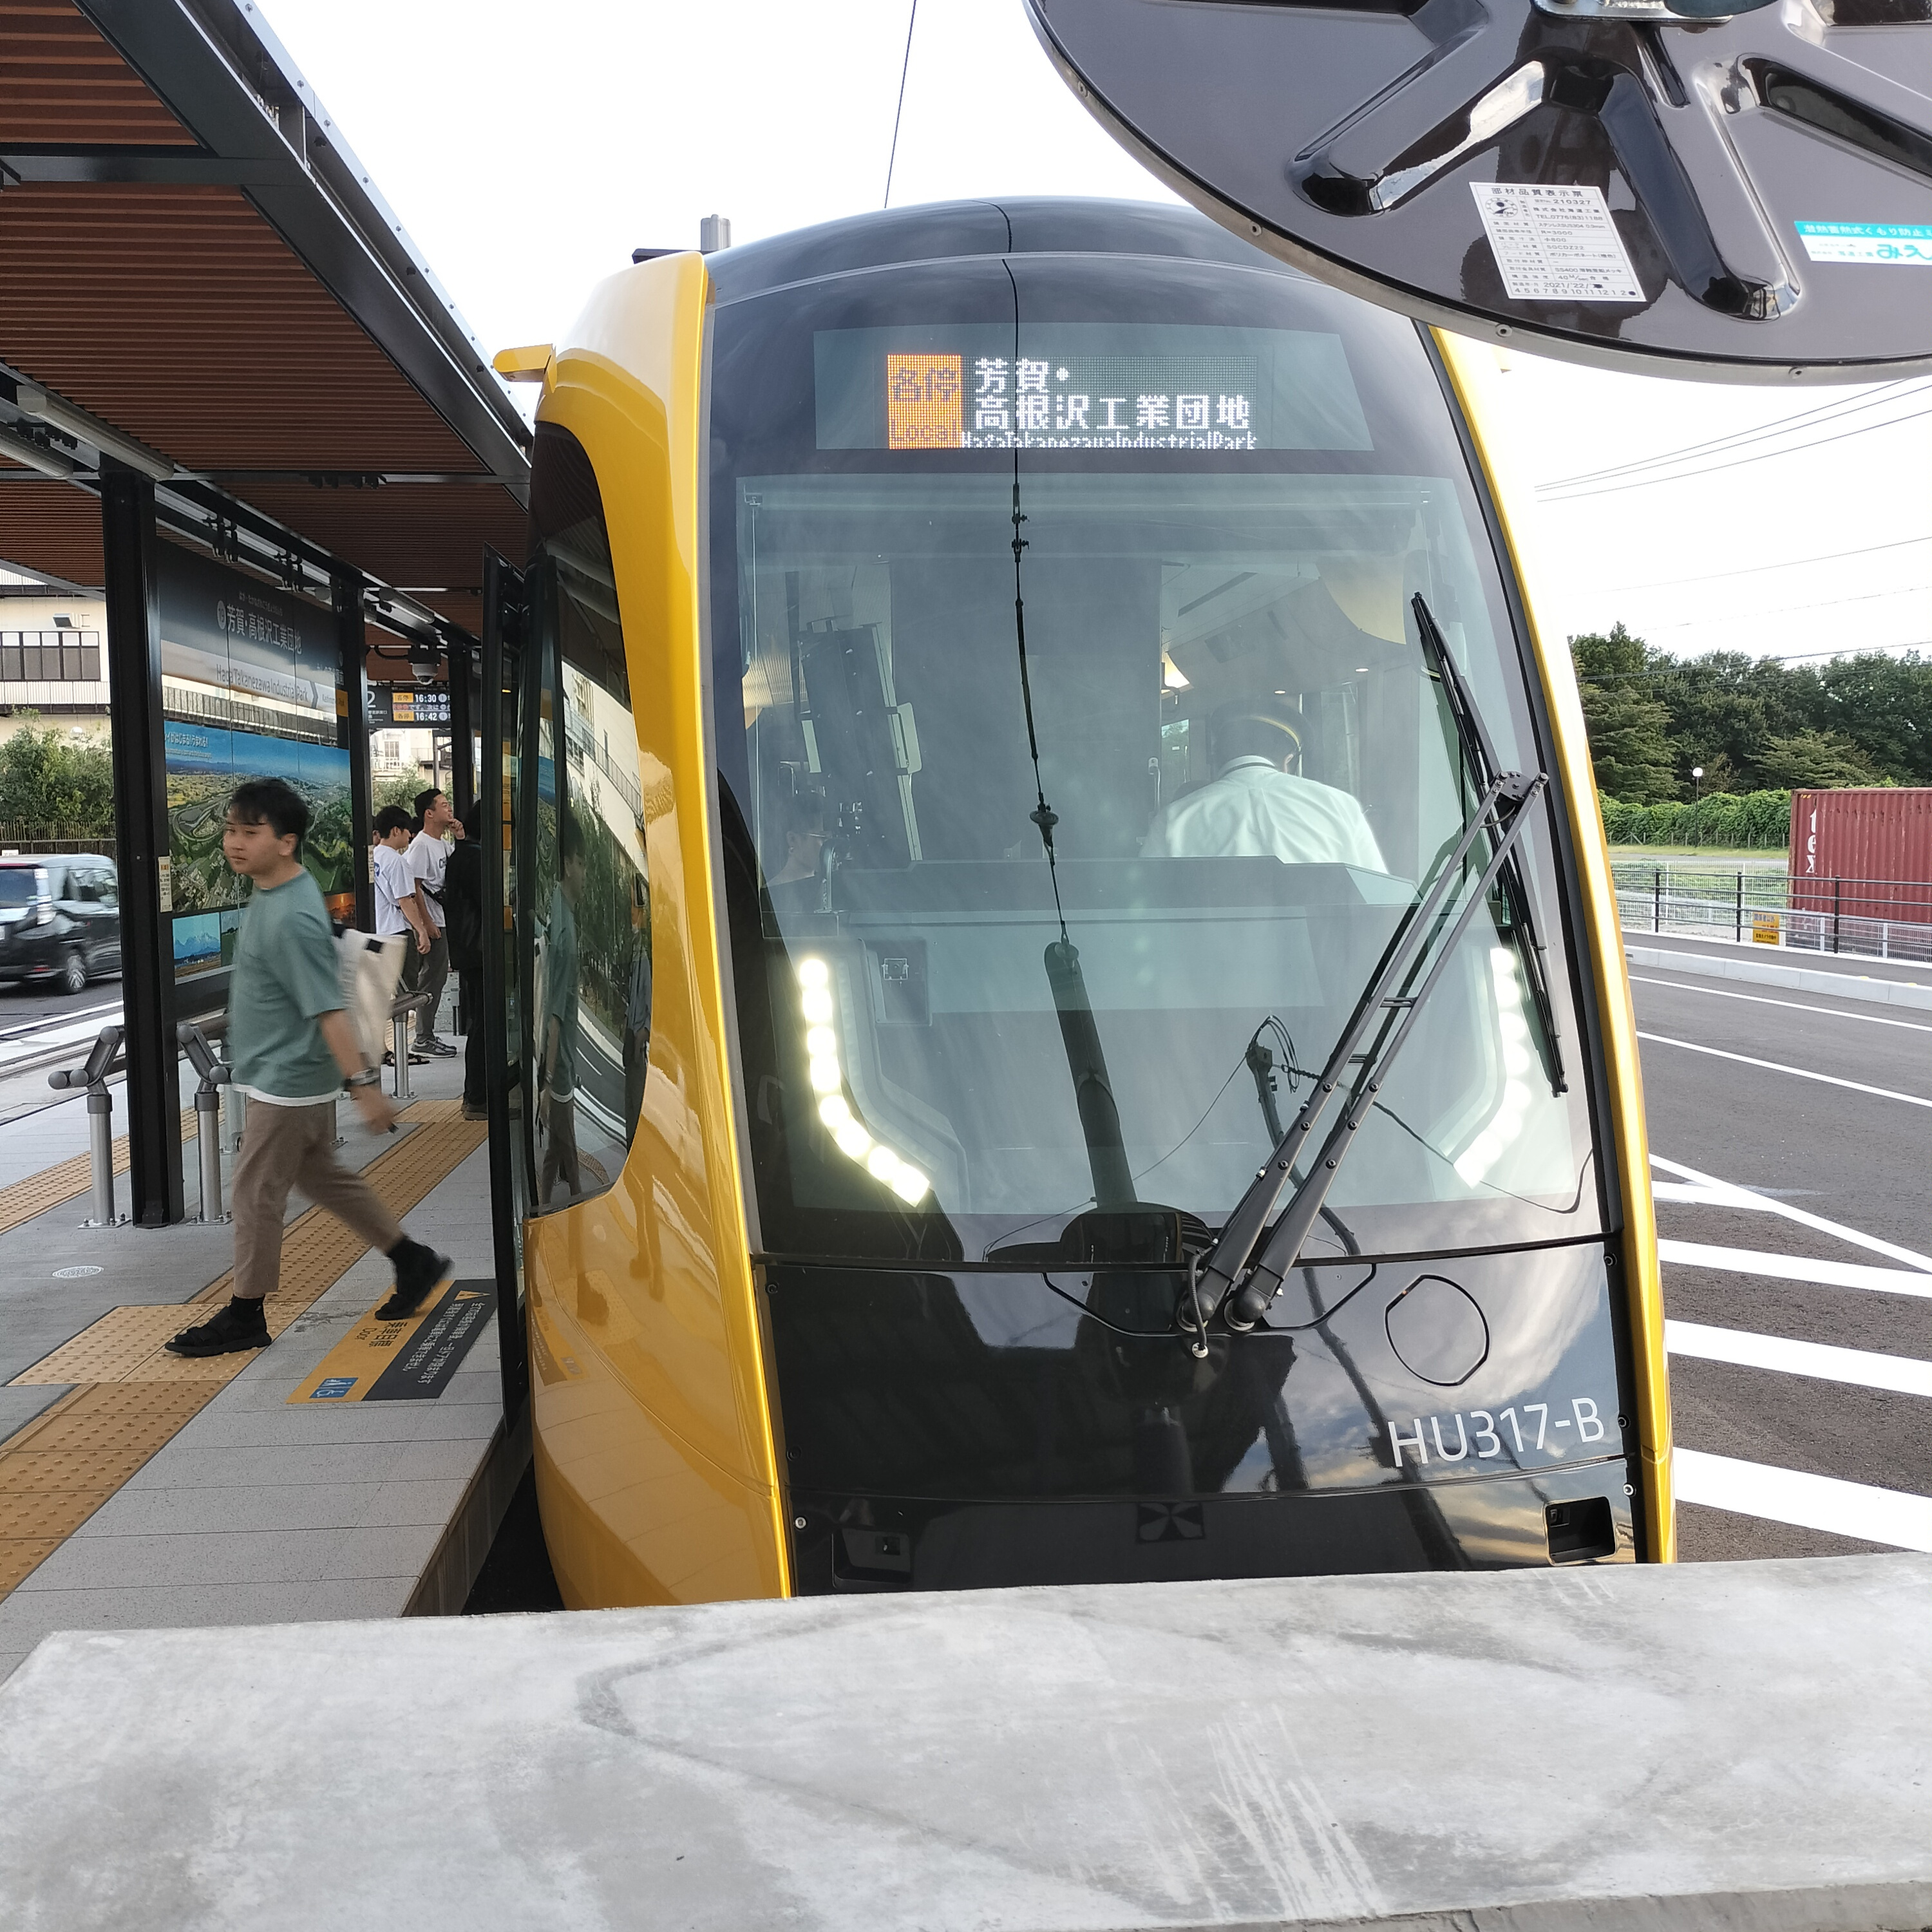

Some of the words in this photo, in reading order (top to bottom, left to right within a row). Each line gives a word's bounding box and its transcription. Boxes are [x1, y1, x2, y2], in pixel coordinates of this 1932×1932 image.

[891, 368, 956, 401] 各停
[975, 395, 1250, 430] 高根沢工業団地
[233, 668, 270, 693] Takanezawa
[297, 685, 308, 701] Park
[415, 694, 437, 703] 16:30
[415, 712, 437, 721] 16:42
[354, 1327, 378, 1340] Door
[1388, 1397, 1604, 1467] HU317-B
